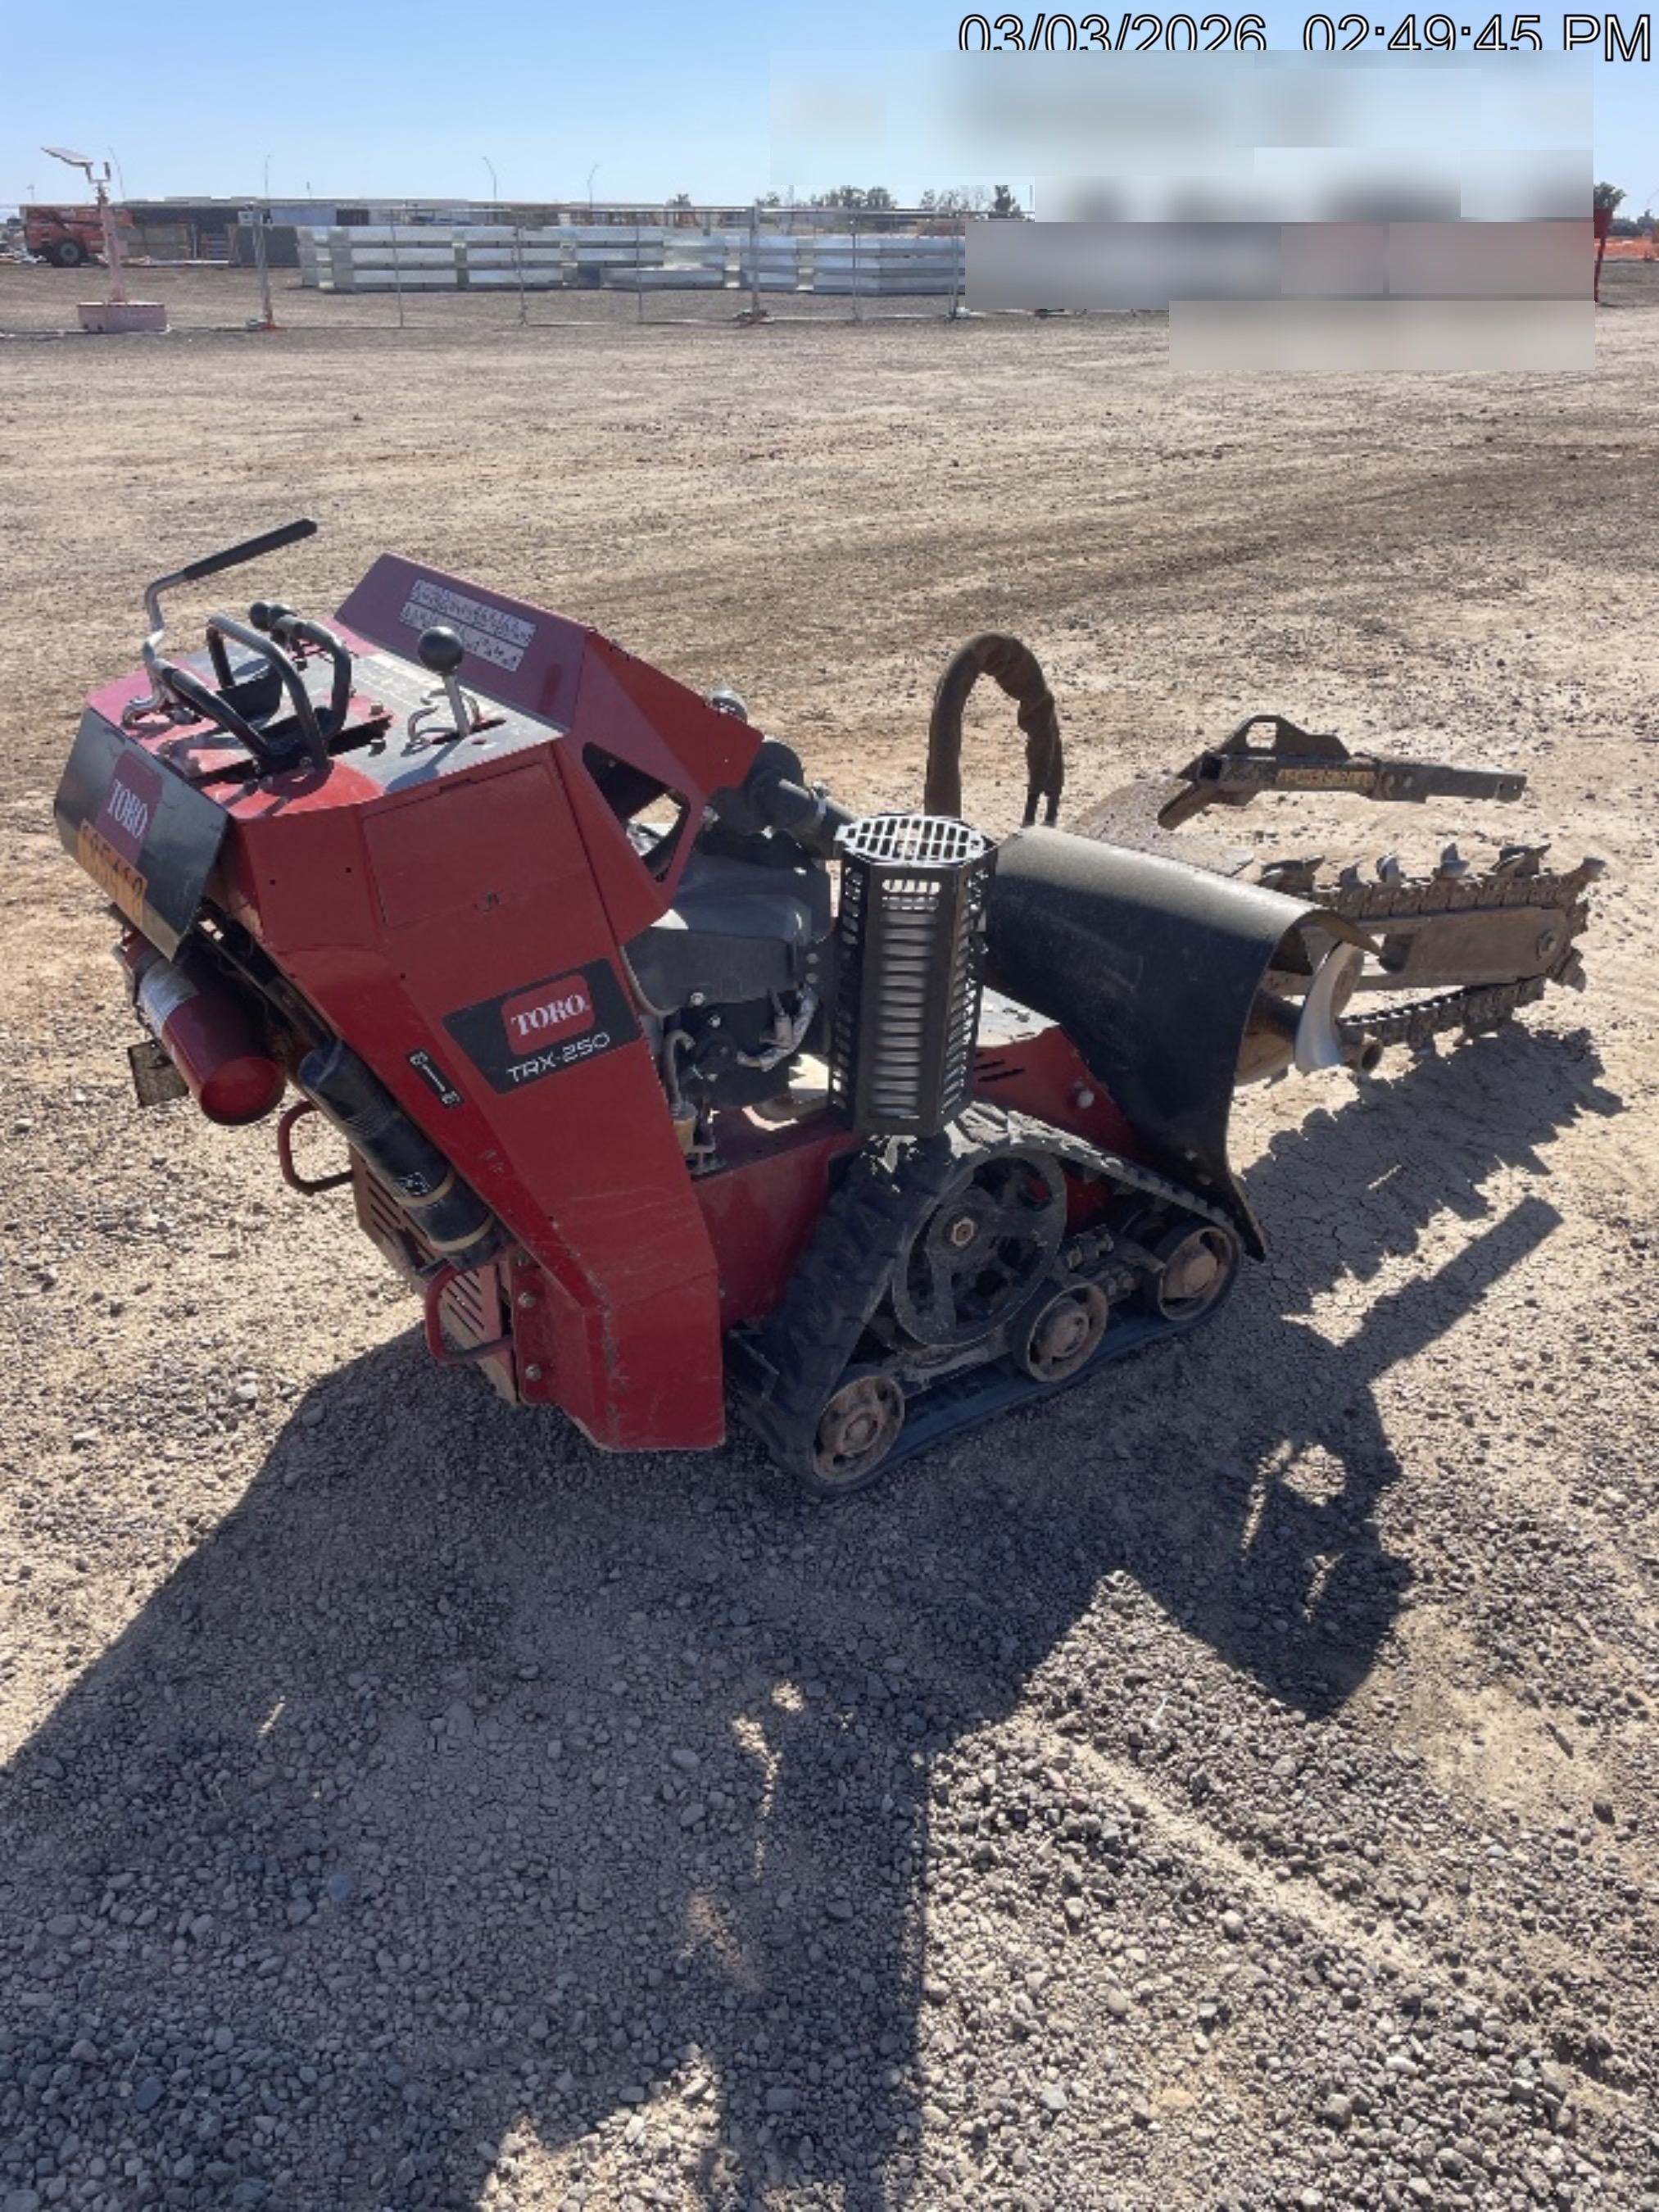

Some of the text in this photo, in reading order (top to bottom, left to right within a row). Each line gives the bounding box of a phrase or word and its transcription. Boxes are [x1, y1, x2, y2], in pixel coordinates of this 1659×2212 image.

[107, 779, 147, 839] TORO
[511, 994, 586, 1036] TORO
[506, 1031, 610, 1081] TRX-250
